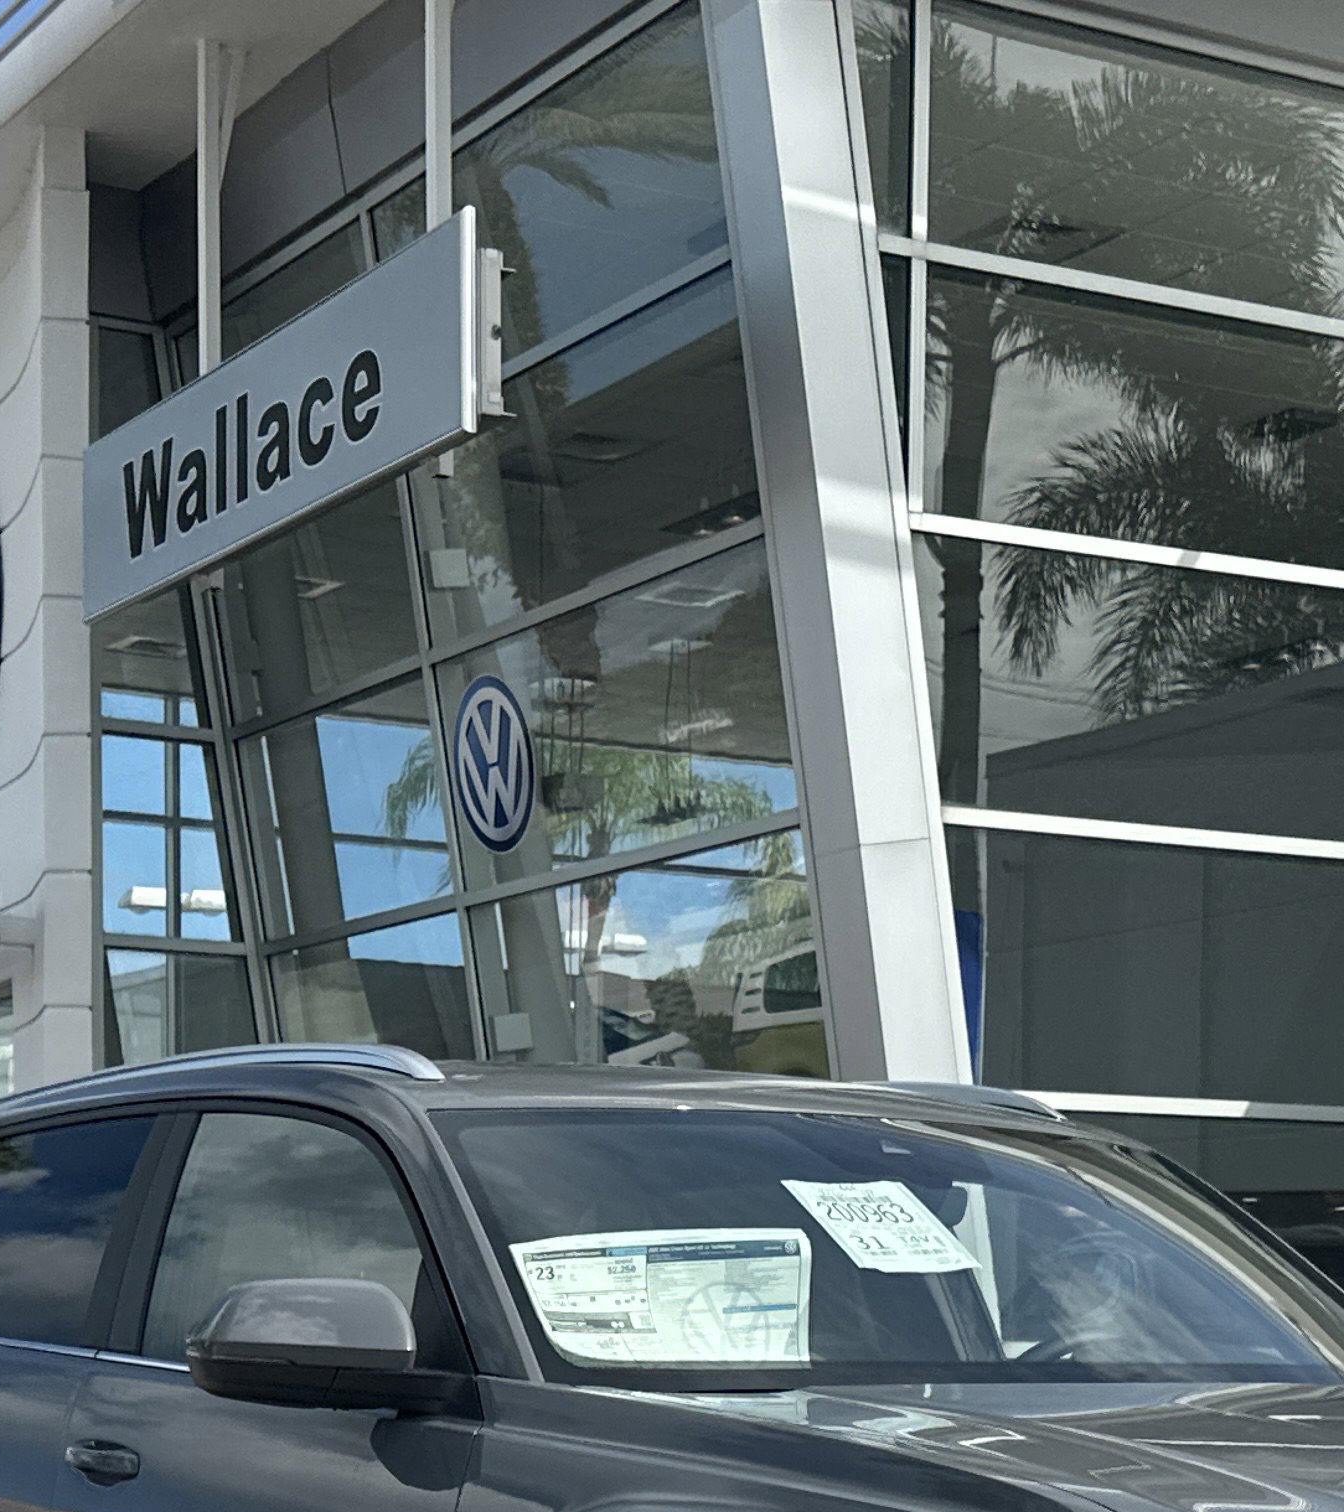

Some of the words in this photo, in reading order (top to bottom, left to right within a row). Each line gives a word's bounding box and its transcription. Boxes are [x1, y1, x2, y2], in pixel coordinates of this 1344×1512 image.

[122, 349, 382, 560] Wallace
[458, 685, 530, 842] VW
[817, 1201, 914, 1224] 200963
[849, 1234, 890, 1250] 31
[536, 1266, 555, 1280] 23
